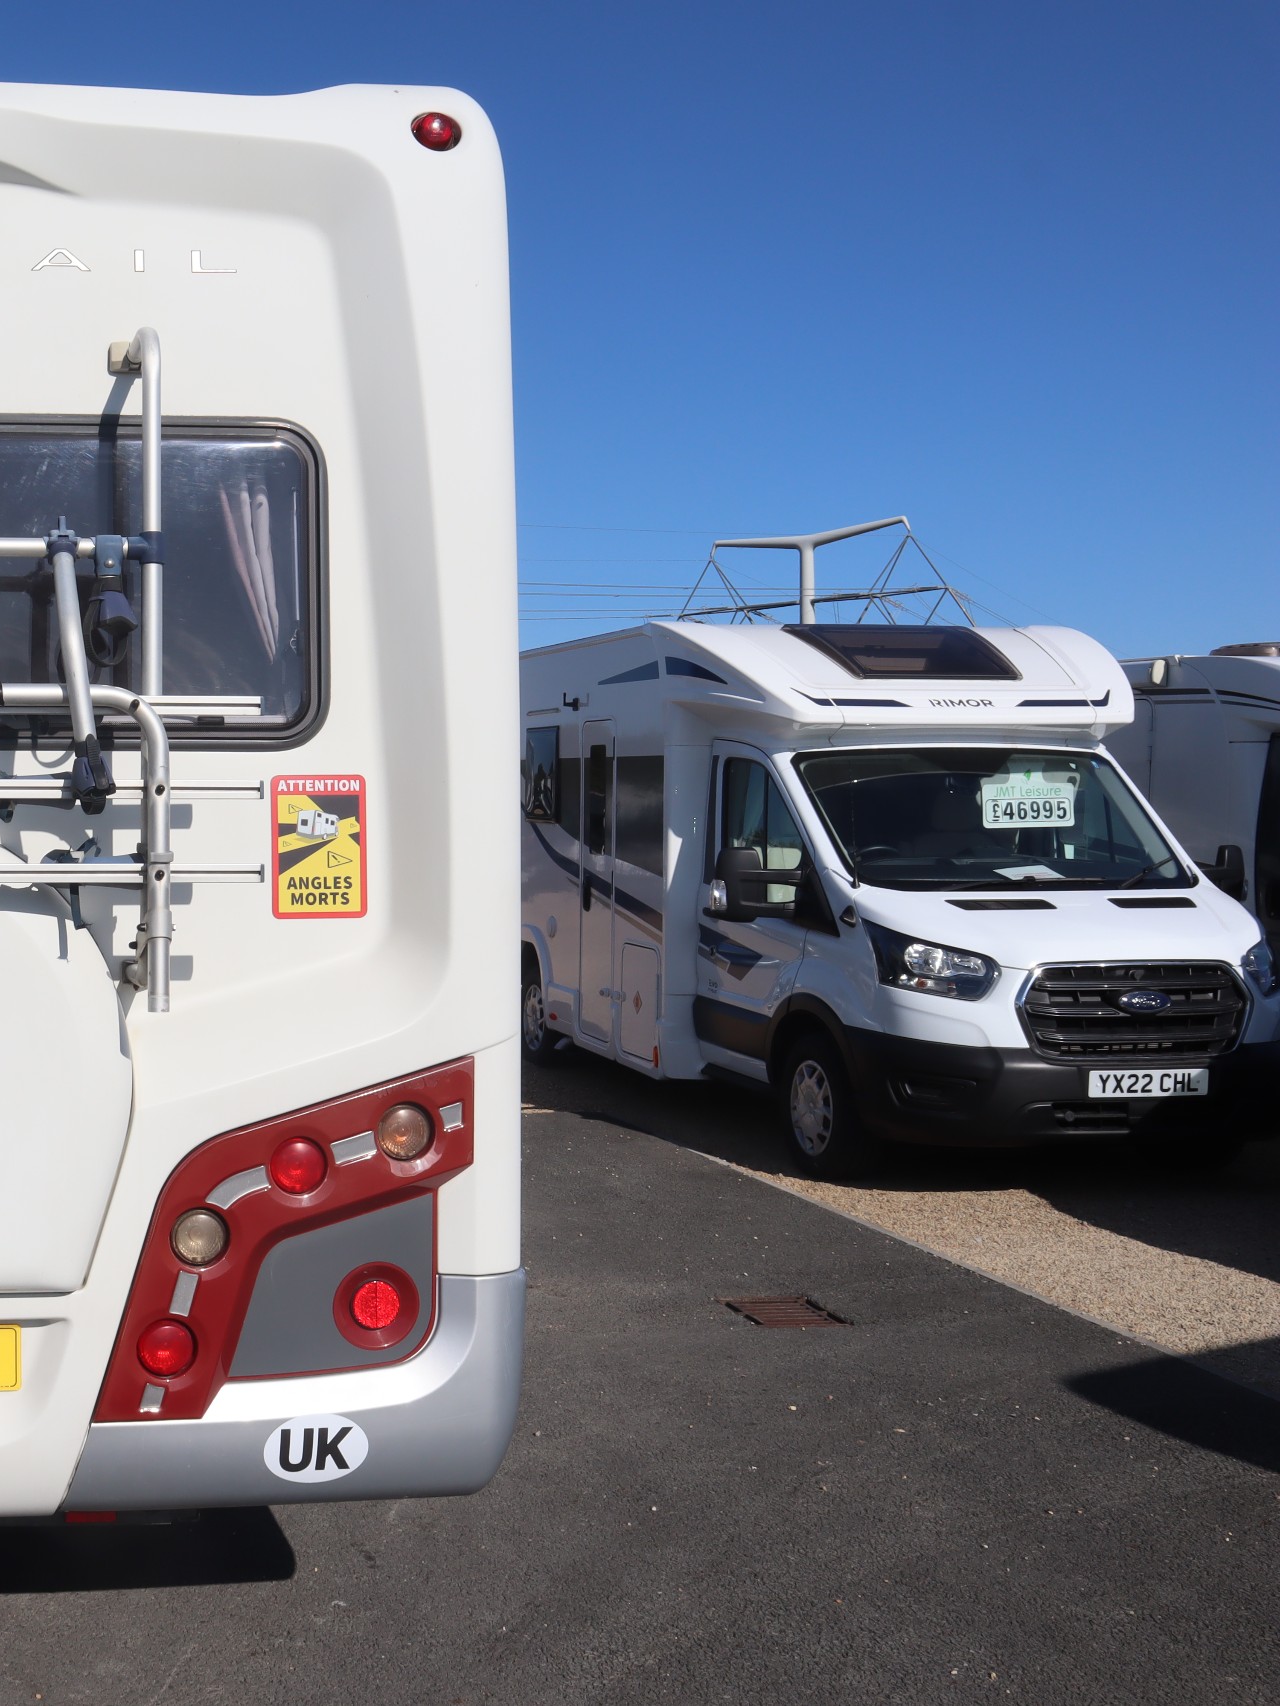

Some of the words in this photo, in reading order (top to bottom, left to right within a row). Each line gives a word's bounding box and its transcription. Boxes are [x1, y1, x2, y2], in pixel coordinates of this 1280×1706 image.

[927, 698, 995, 708] RIMOR
[277, 779, 360, 792] ATTENTION
[993, 785, 1016, 797] JMT
[1019, 785, 1062, 797] Leisure
[991, 800, 1068, 822] £46995
[286, 876, 353, 890] ANGLES
[290, 892, 350, 906] MORTS
[1098, 1073, 1154, 1094] YX22
[1159, 1072, 1199, 1093] CHL
[279, 1426, 354, 1473] UK
